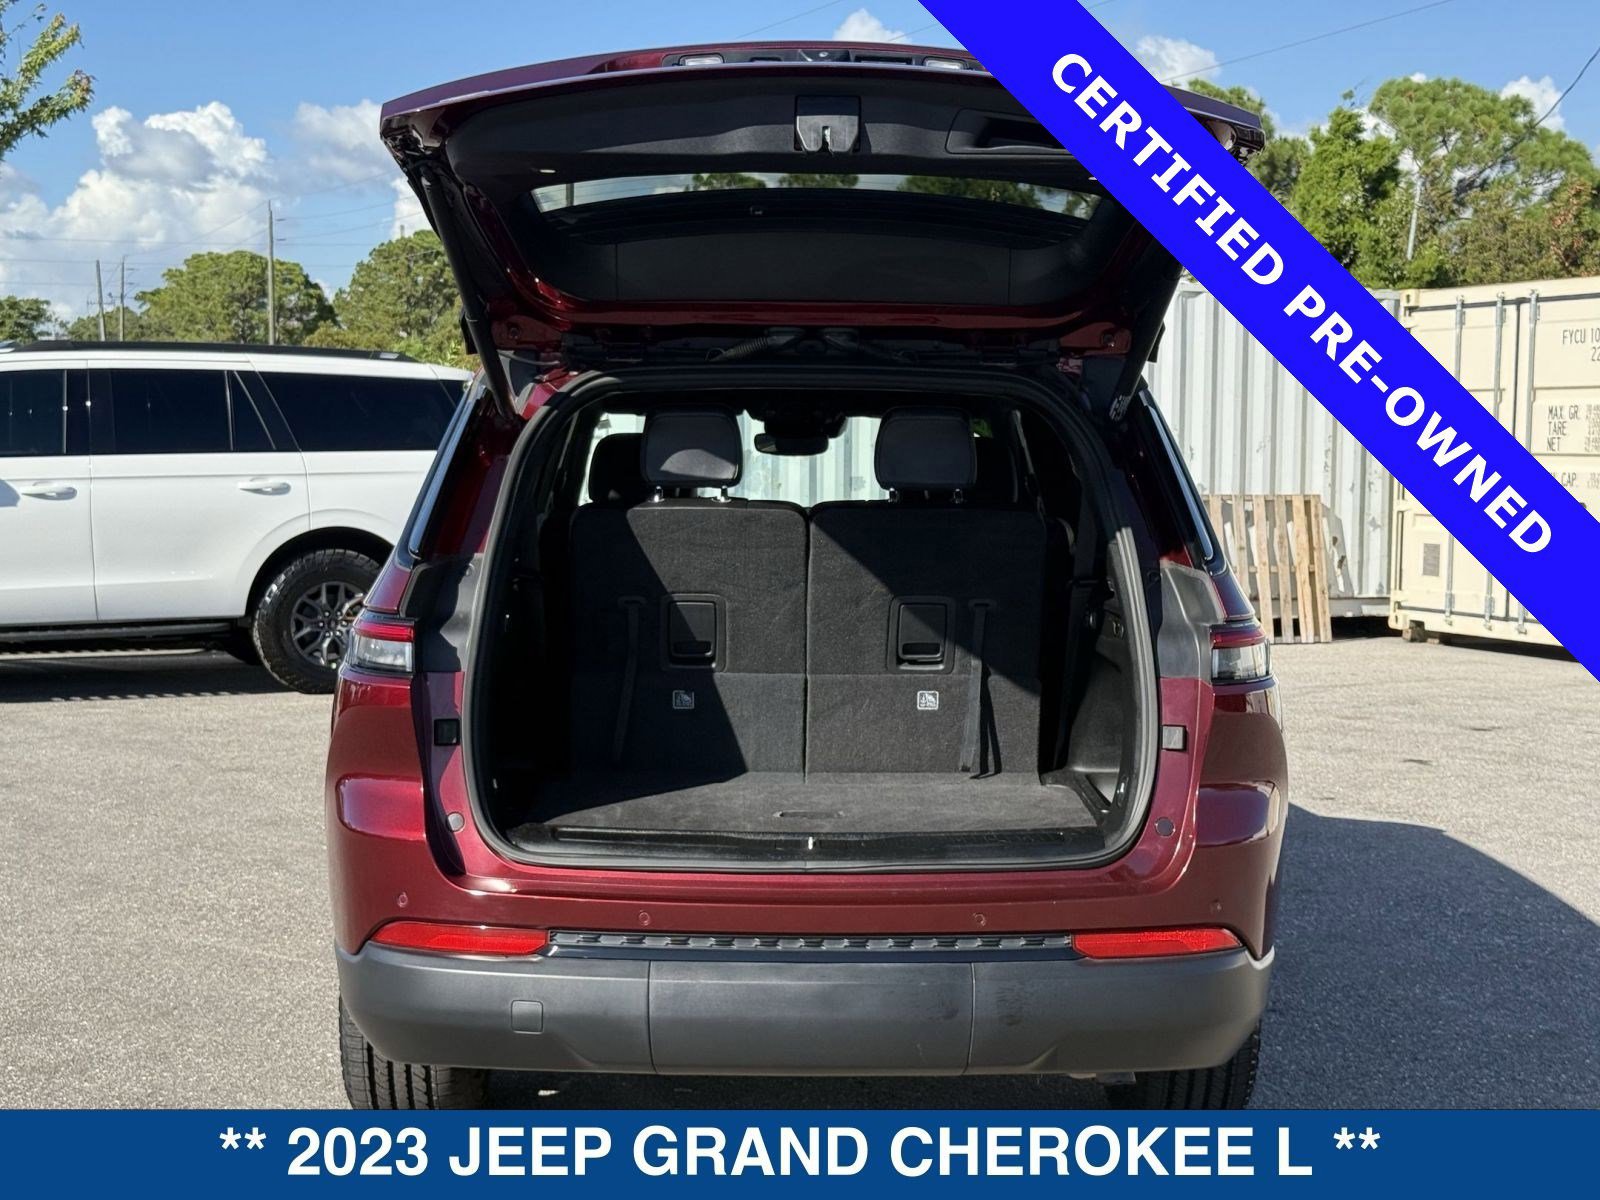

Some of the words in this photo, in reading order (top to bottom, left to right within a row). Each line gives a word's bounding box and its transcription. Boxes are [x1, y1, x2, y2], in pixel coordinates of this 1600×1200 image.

[1562, 328, 1586, 345] FYCU
[1548, 420, 1567, 436] TARE
[1546, 436, 1561, 452] NET
